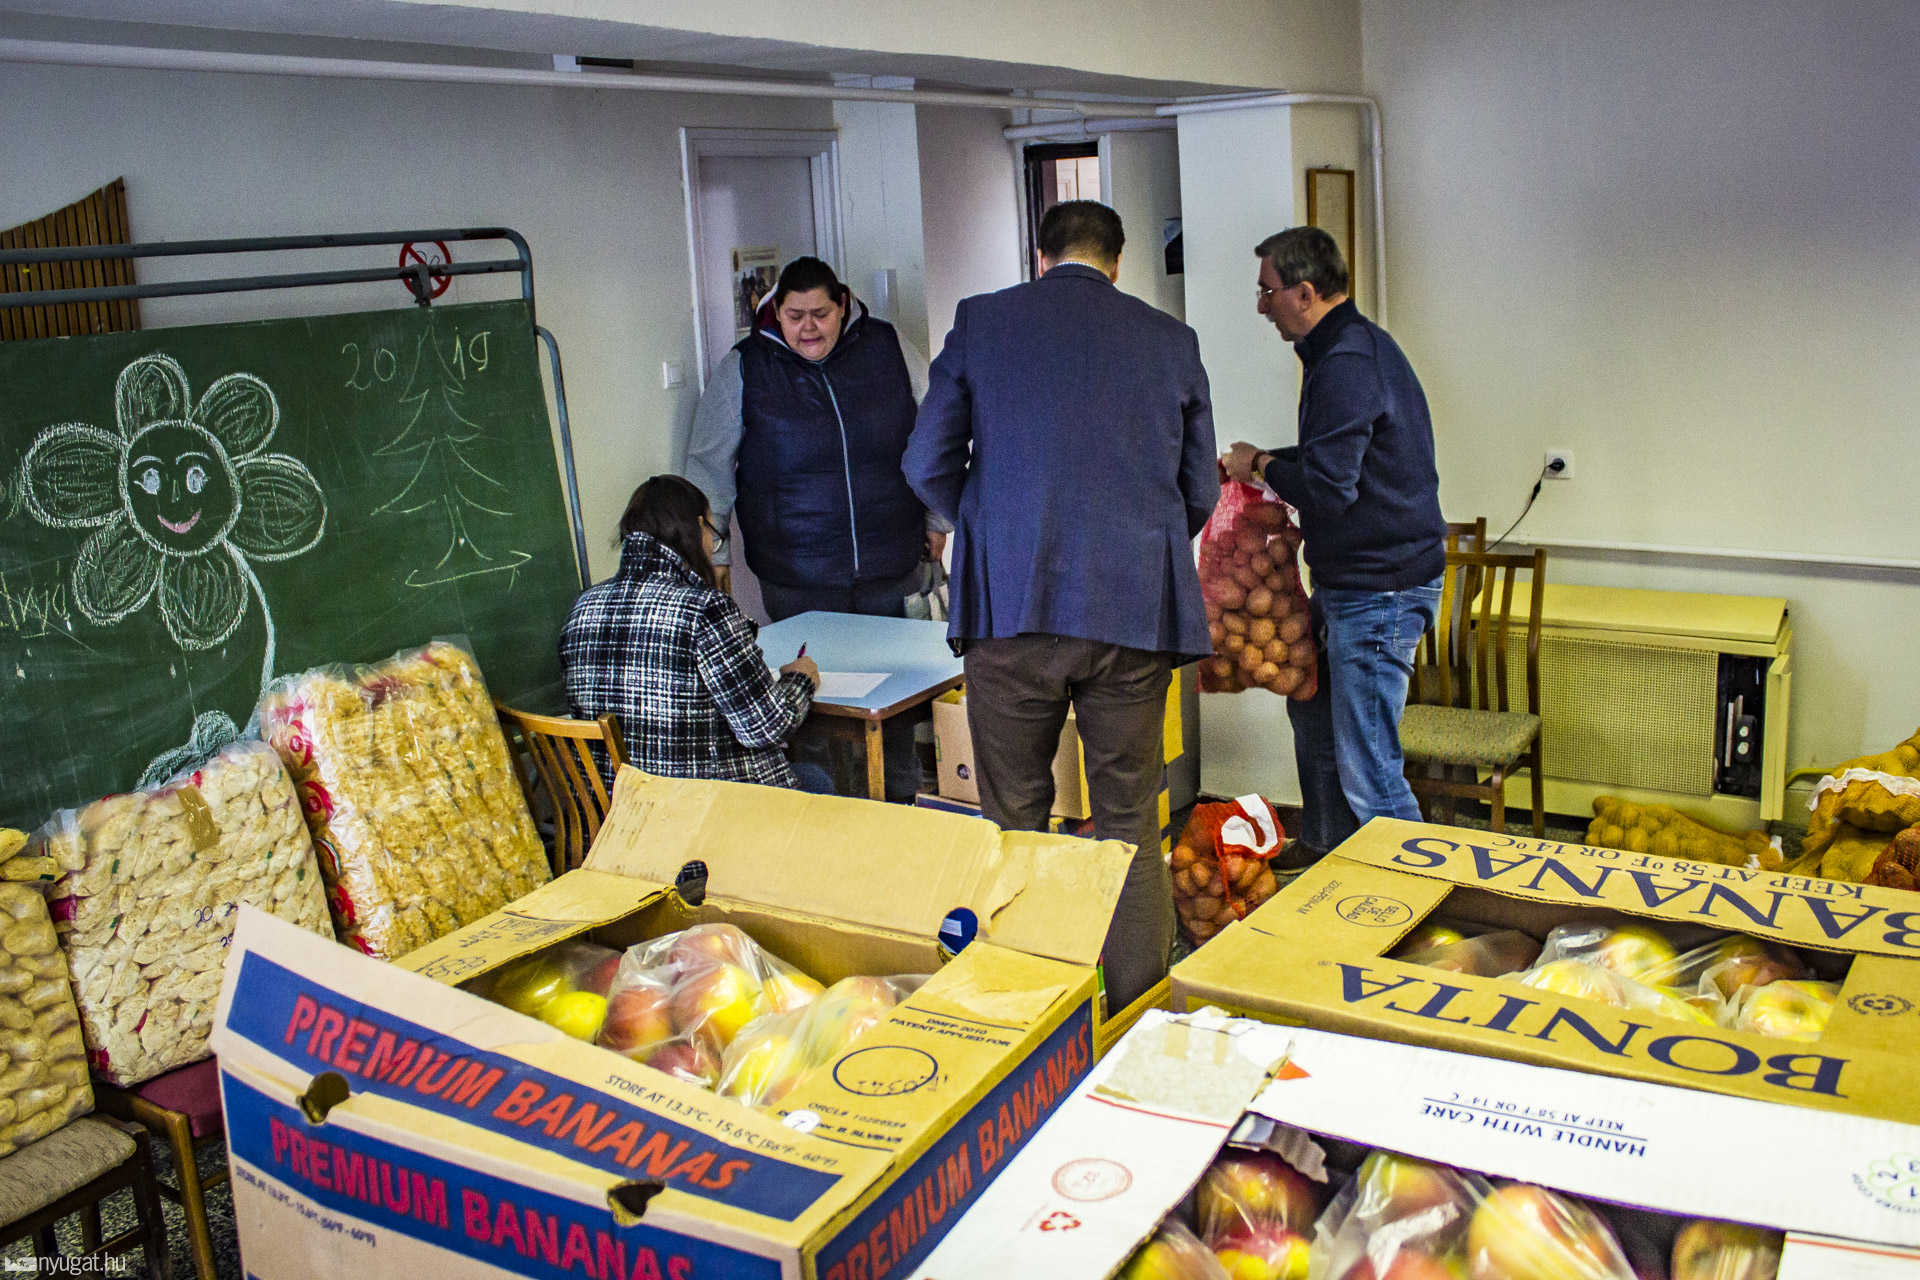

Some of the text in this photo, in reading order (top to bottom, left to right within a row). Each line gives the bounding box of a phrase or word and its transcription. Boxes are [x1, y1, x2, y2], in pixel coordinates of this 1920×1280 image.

[1580, 846, 1620, 861] OR
[1713, 866, 1759, 882] AT
[1770, 878, 1864, 900] KEEP
[890, 1017, 1011, 1047] PATENT APPLIED FOR
[1335, 961, 1853, 1100] BONITA
[284, 994, 754, 1190] PREMIUM BANANAS
[604, 1074, 647, 1097] STORE
[645, 1092, 666, 1105] AT
[977, 1023, 1088, 1176] BANANAS
[1495, 1101, 1517, 1112] OR
[1563, 1111, 1581, 1123] AT
[1422, 1103, 1646, 1157] HANDLE WITH CARE
[1586, 1117, 1625, 1131] KEEP
[270, 1116, 449, 1230] PREMIUM
[462, 1178, 692, 1280] BANANAS
